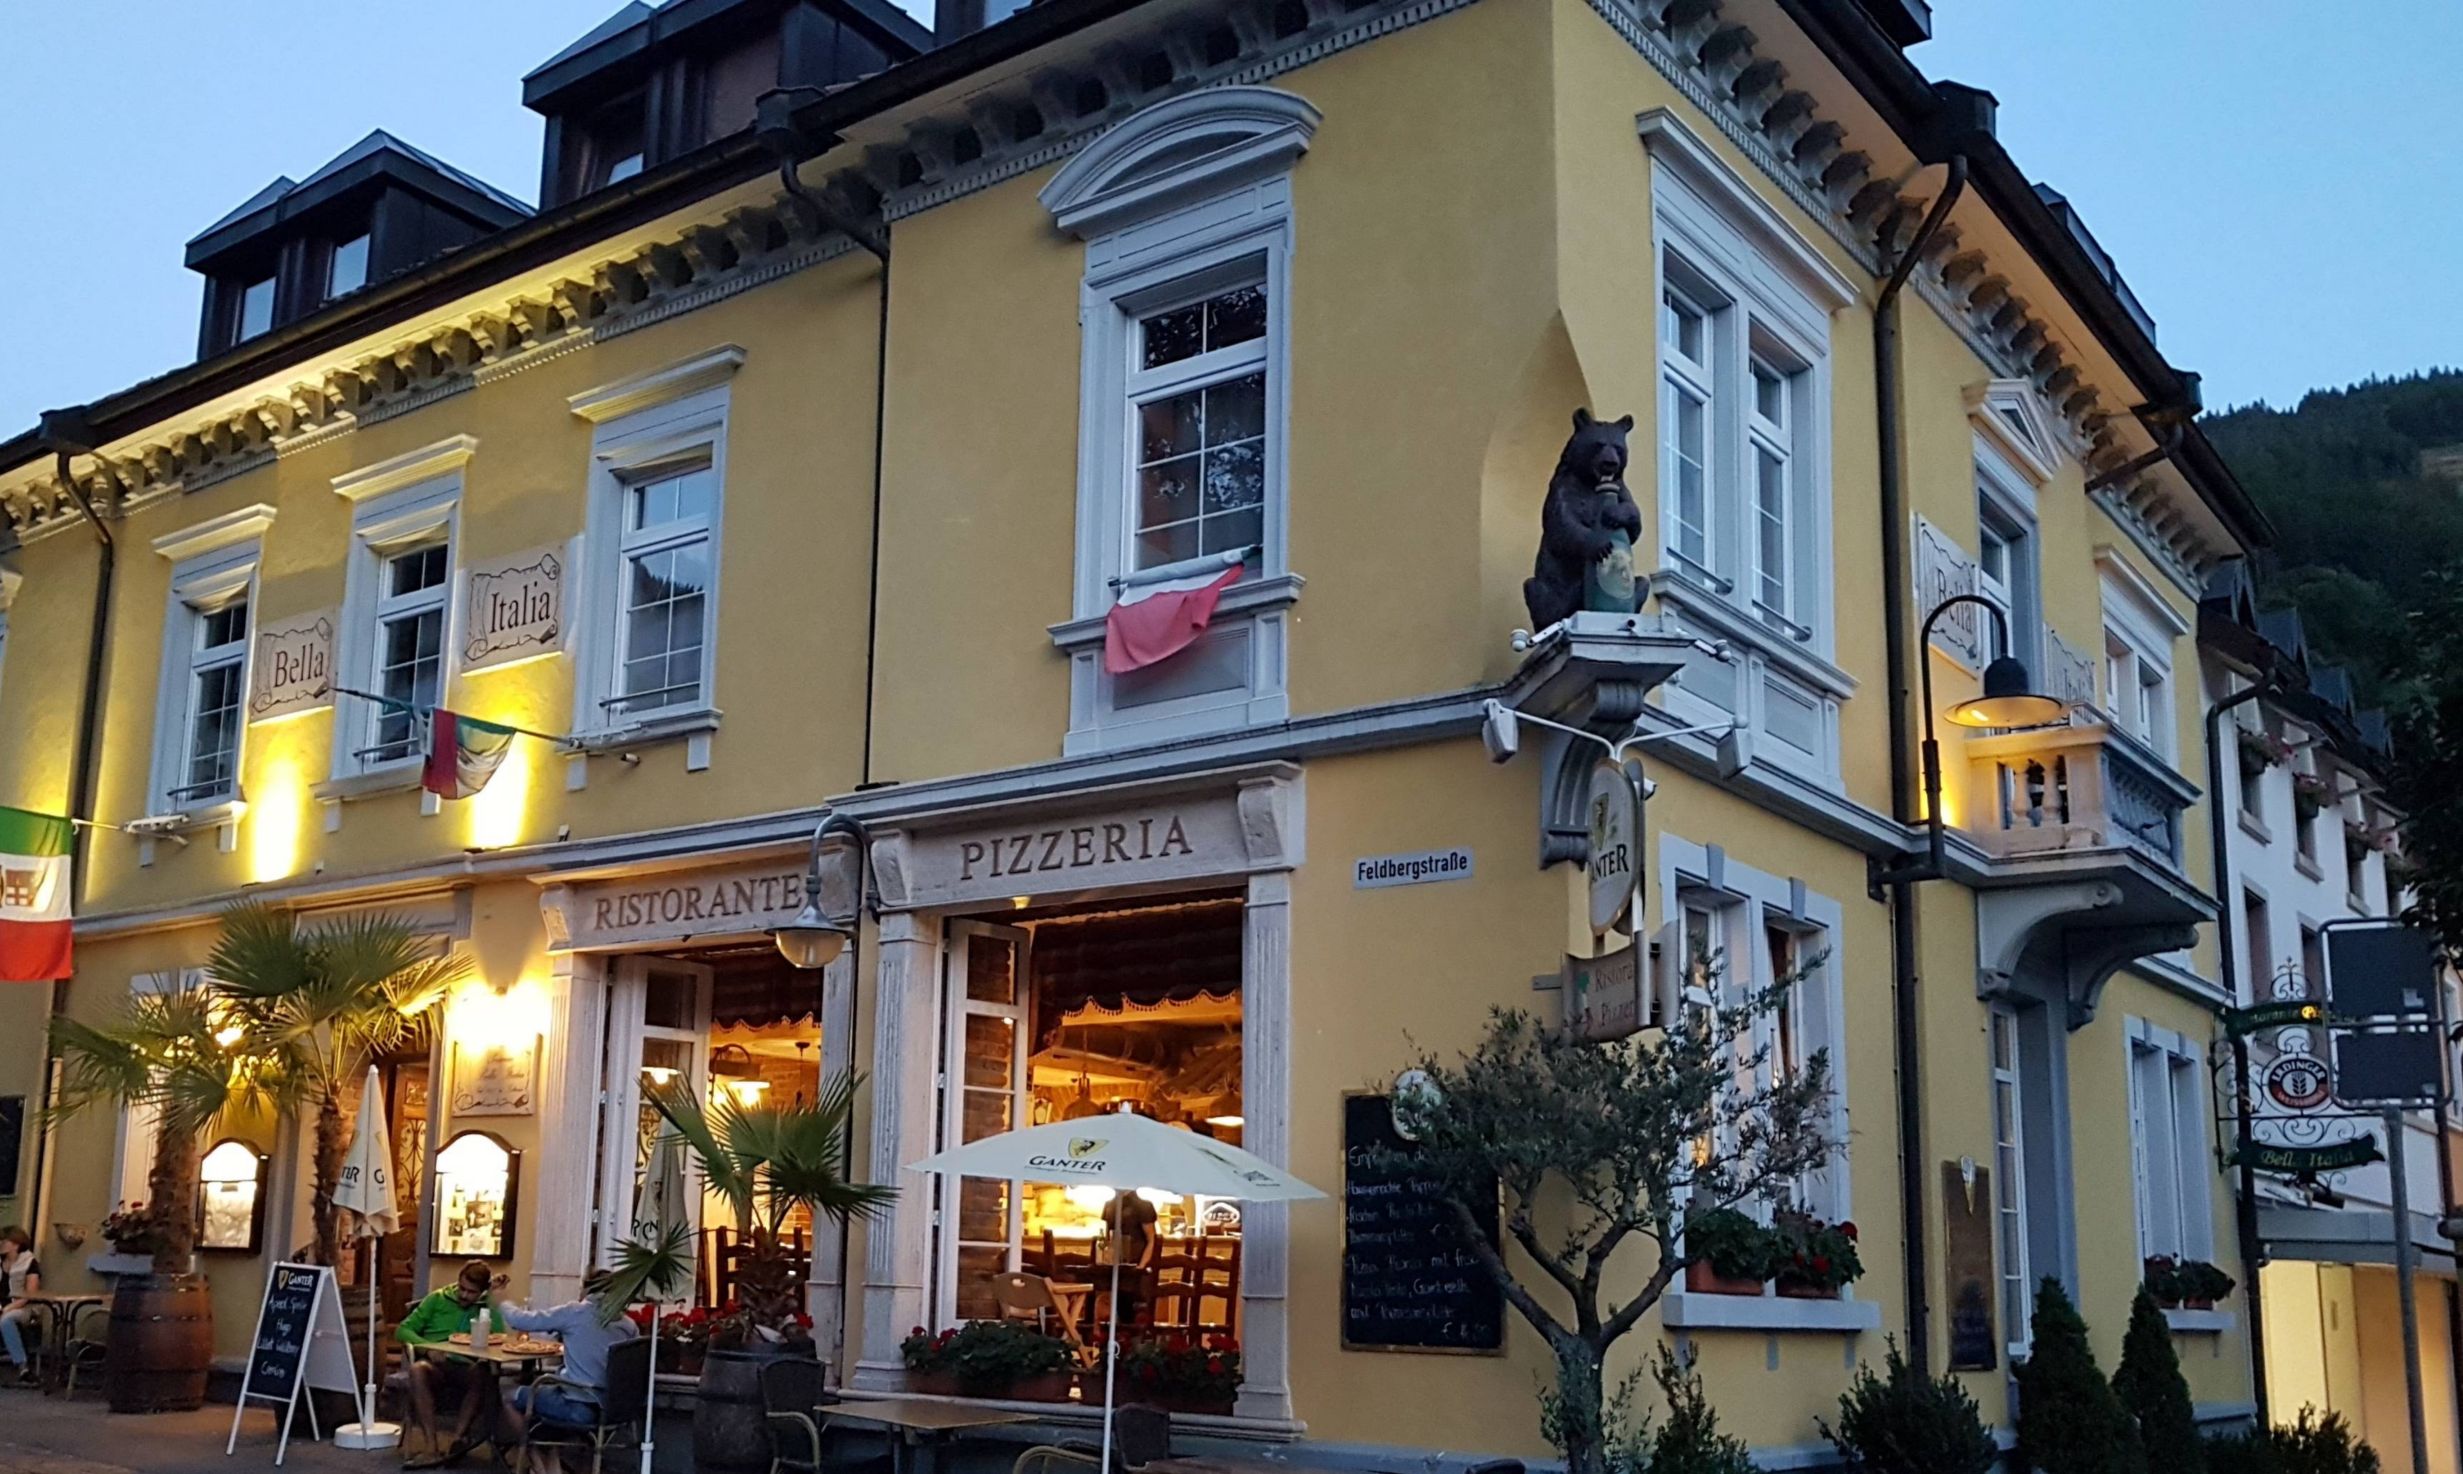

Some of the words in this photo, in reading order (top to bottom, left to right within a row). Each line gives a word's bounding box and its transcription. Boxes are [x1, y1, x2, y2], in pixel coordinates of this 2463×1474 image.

[489, 581, 551, 633] Italia
[274, 642, 324, 688] Bella
[960, 815, 1193, 880] PIZZERIA
[1591, 843, 1629, 882] ANTER
[1358, 851, 1468, 881] Feldbergstraße
[594, 874, 802, 931] RISTORANTE
[1594, 964, 1633, 992] Ristora
[2271, 1060, 2327, 1083] ERDINGER
[1029, 1155, 1106, 1171] GANTER
[2260, 1150, 2297, 1168] Bell
[288, 1272, 314, 1288] GANTER
